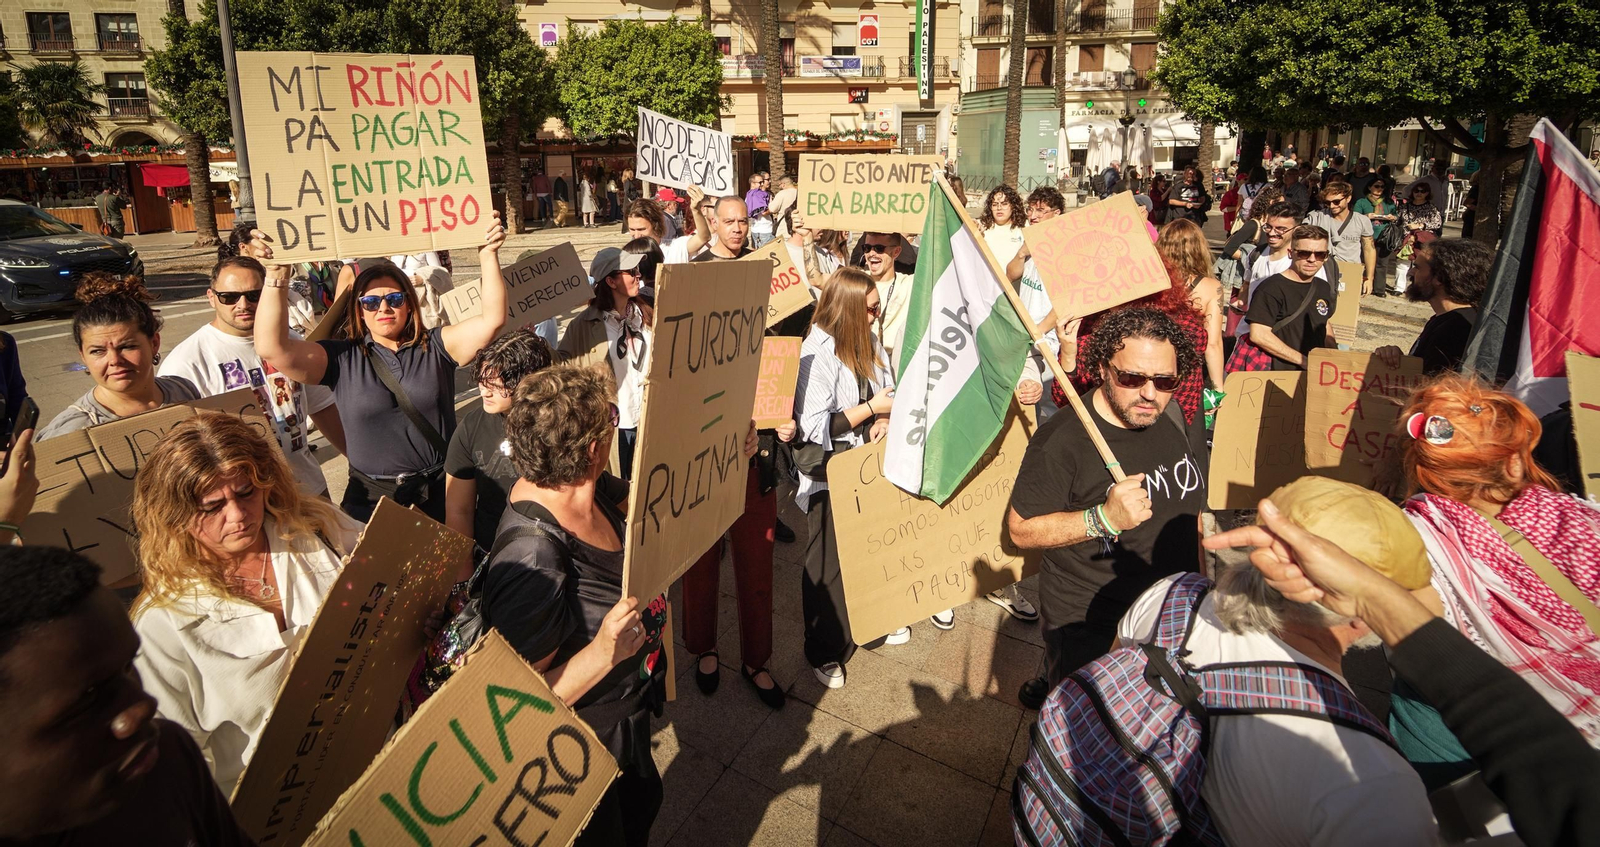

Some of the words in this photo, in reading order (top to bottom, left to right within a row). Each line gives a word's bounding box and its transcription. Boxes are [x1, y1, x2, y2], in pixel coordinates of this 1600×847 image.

[267, 65, 336, 112] MI
[346, 59, 472, 108] RIÑÓN
[921, 22, 929, 95] PALESTINA
[285, 114, 341, 153] PA
[351, 109, 472, 153] PAGAR
[641, 111, 674, 150] NOS
[677, 124, 730, 164] DEJAN
[265, 169, 324, 211] LA
[332, 155, 474, 204] ENTRADA
[639, 144, 666, 180] SIN
[667, 154, 727, 191] CASAS
[806, 158, 836, 184] TO
[843, 160, 885, 185] ESTO
[276, 214, 327, 251] DE
[338, 200, 391, 233] UN
[399, 193, 480, 236] PISO
[807, 191, 844, 216] ERA
[850, 190, 926, 216] BARRIO
[454, 286, 482, 314] LA
[517, 274, 581, 313] DERECHO
[663, 304, 765, 379] TURISMO
[640, 431, 740, 547] RUINA
[867, 508, 939, 555] SOMOS
[949, 477, 1018, 517] NOSOTR
[883, 550, 925, 582] LXS
[948, 519, 990, 555] QUE
[906, 542, 1019, 604] PAGAMOS
[470, 724, 591, 847] ERO
